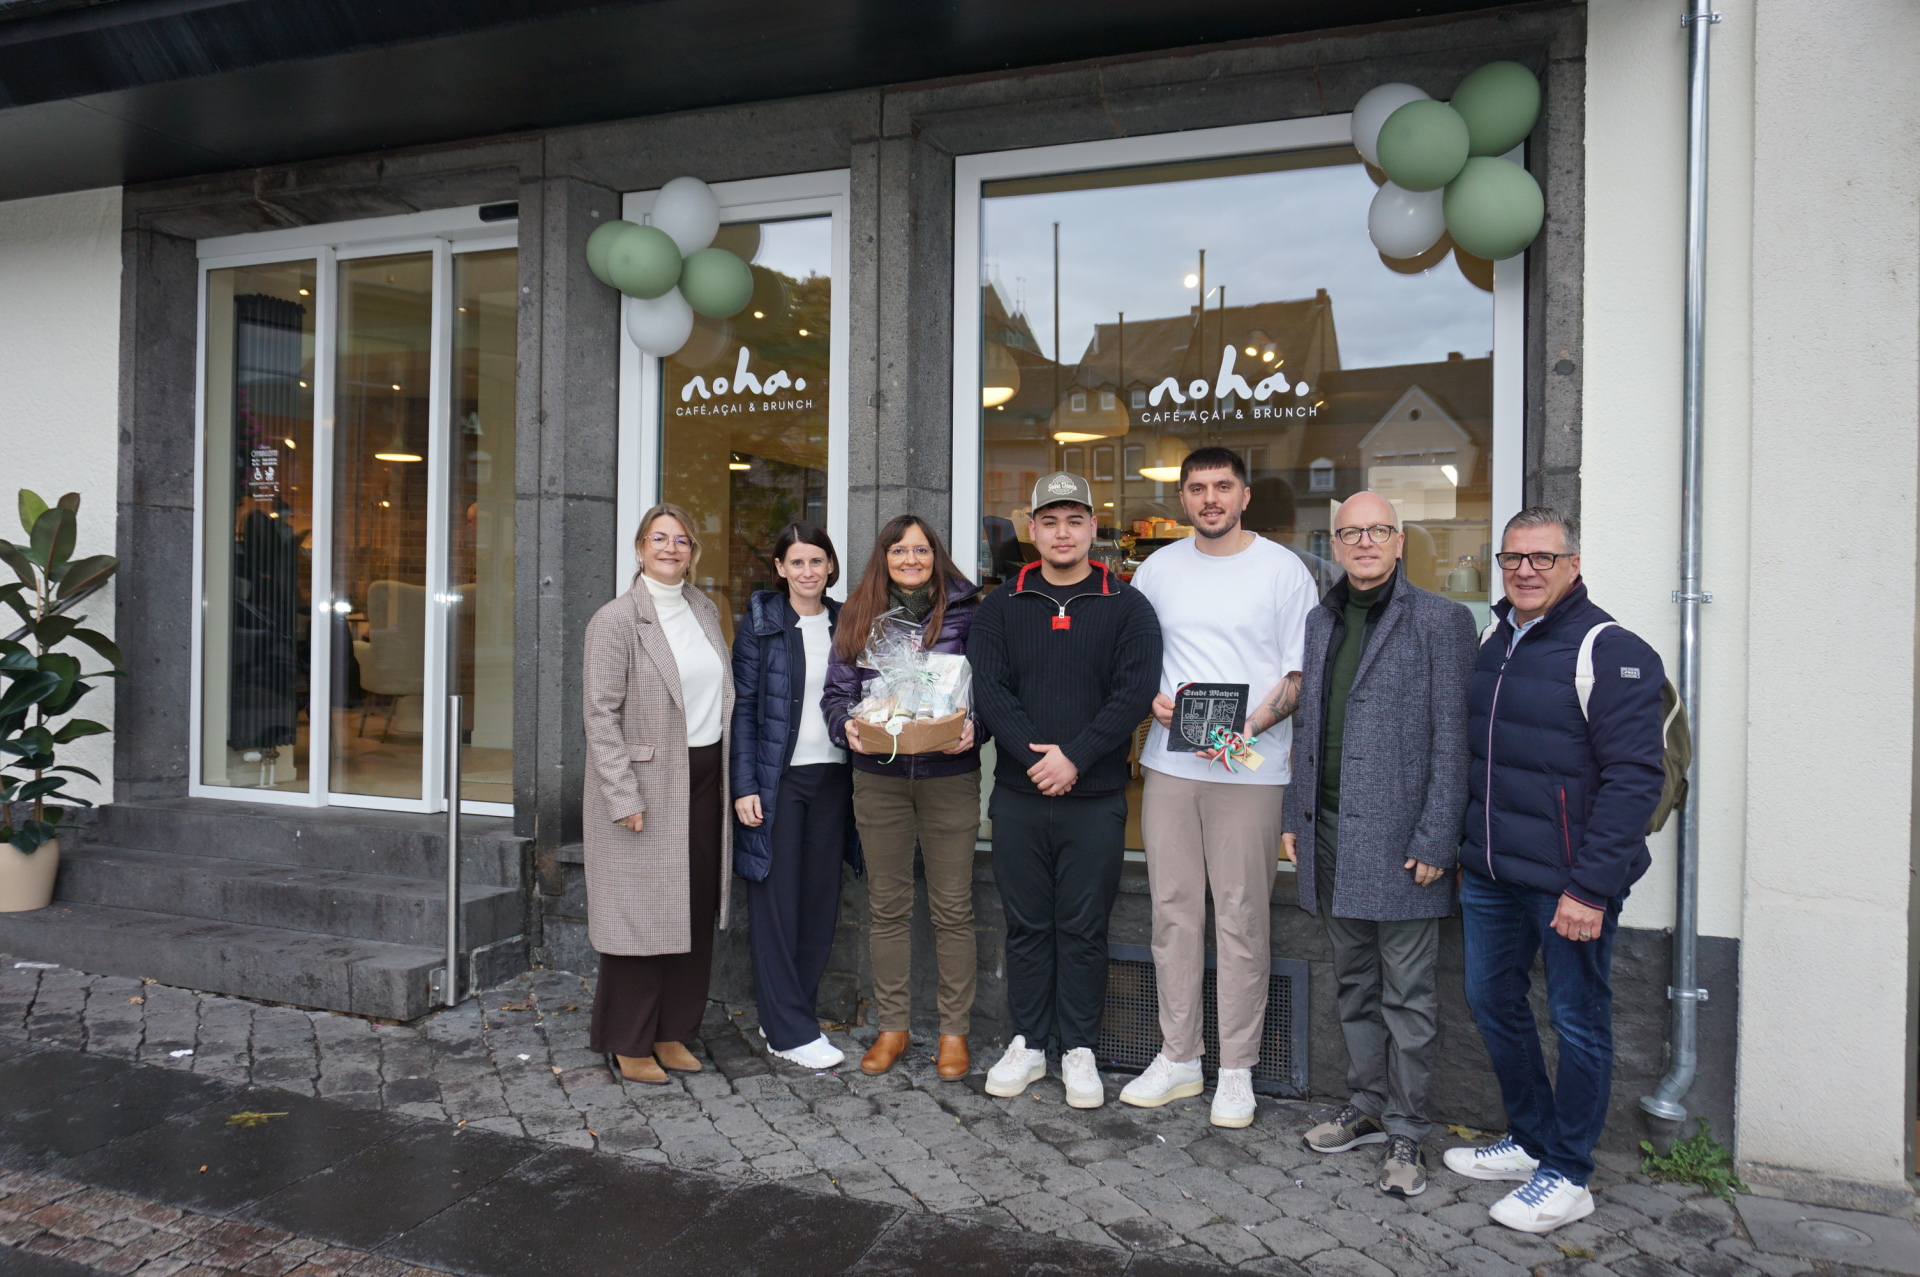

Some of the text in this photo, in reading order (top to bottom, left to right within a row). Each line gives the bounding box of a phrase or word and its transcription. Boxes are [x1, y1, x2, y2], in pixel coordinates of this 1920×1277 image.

[681, 346, 807, 402] noha.
[1148, 344, 1310, 407] noha.
[748, 402, 756, 412] &
[763, 399, 813, 411] BRUNCH
[1235, 409, 1244, 420] &
[1254, 406, 1318, 419] BRUNCH
[1183, 689, 1240, 698] Stadt Mayen
